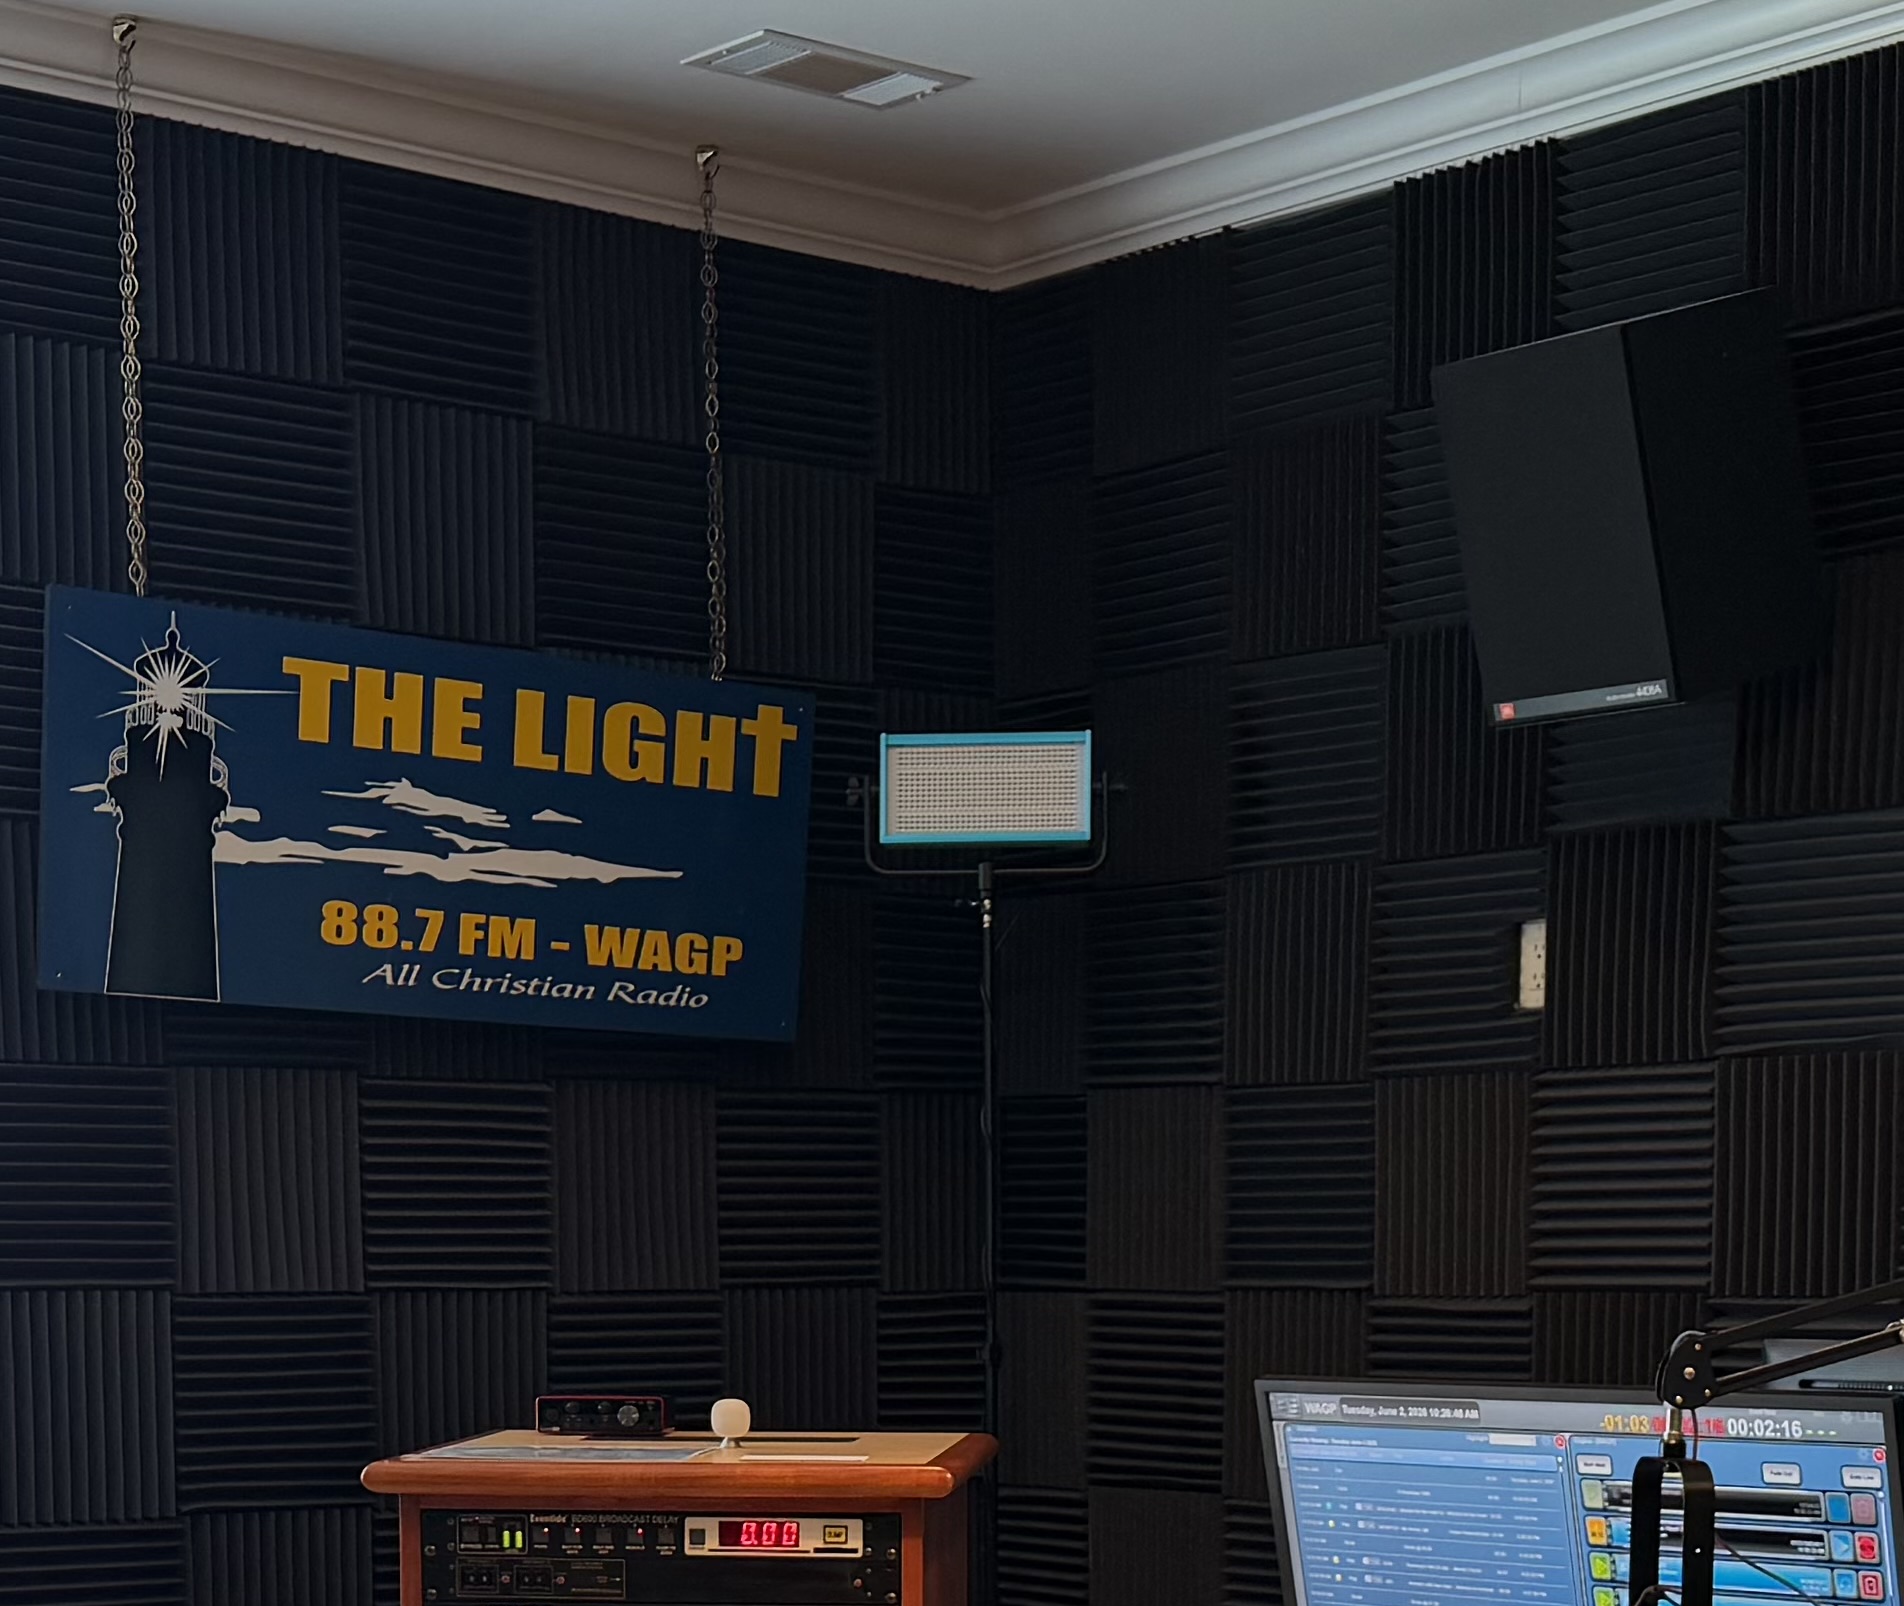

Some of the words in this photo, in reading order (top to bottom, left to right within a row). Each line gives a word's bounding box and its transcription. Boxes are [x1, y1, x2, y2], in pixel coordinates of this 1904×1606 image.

[282, 656, 484, 762] THE
[320, 900, 443, 954] 88.7
[458, 913, 536, 961] FM
[584, 924, 744, 977] WAGP
[362, 962, 419, 988] All
[431, 967, 594, 1002] Christian
[605, 979, 709, 1009] Radio
[1727, 1418, 1803, 1438] 00:02:16
